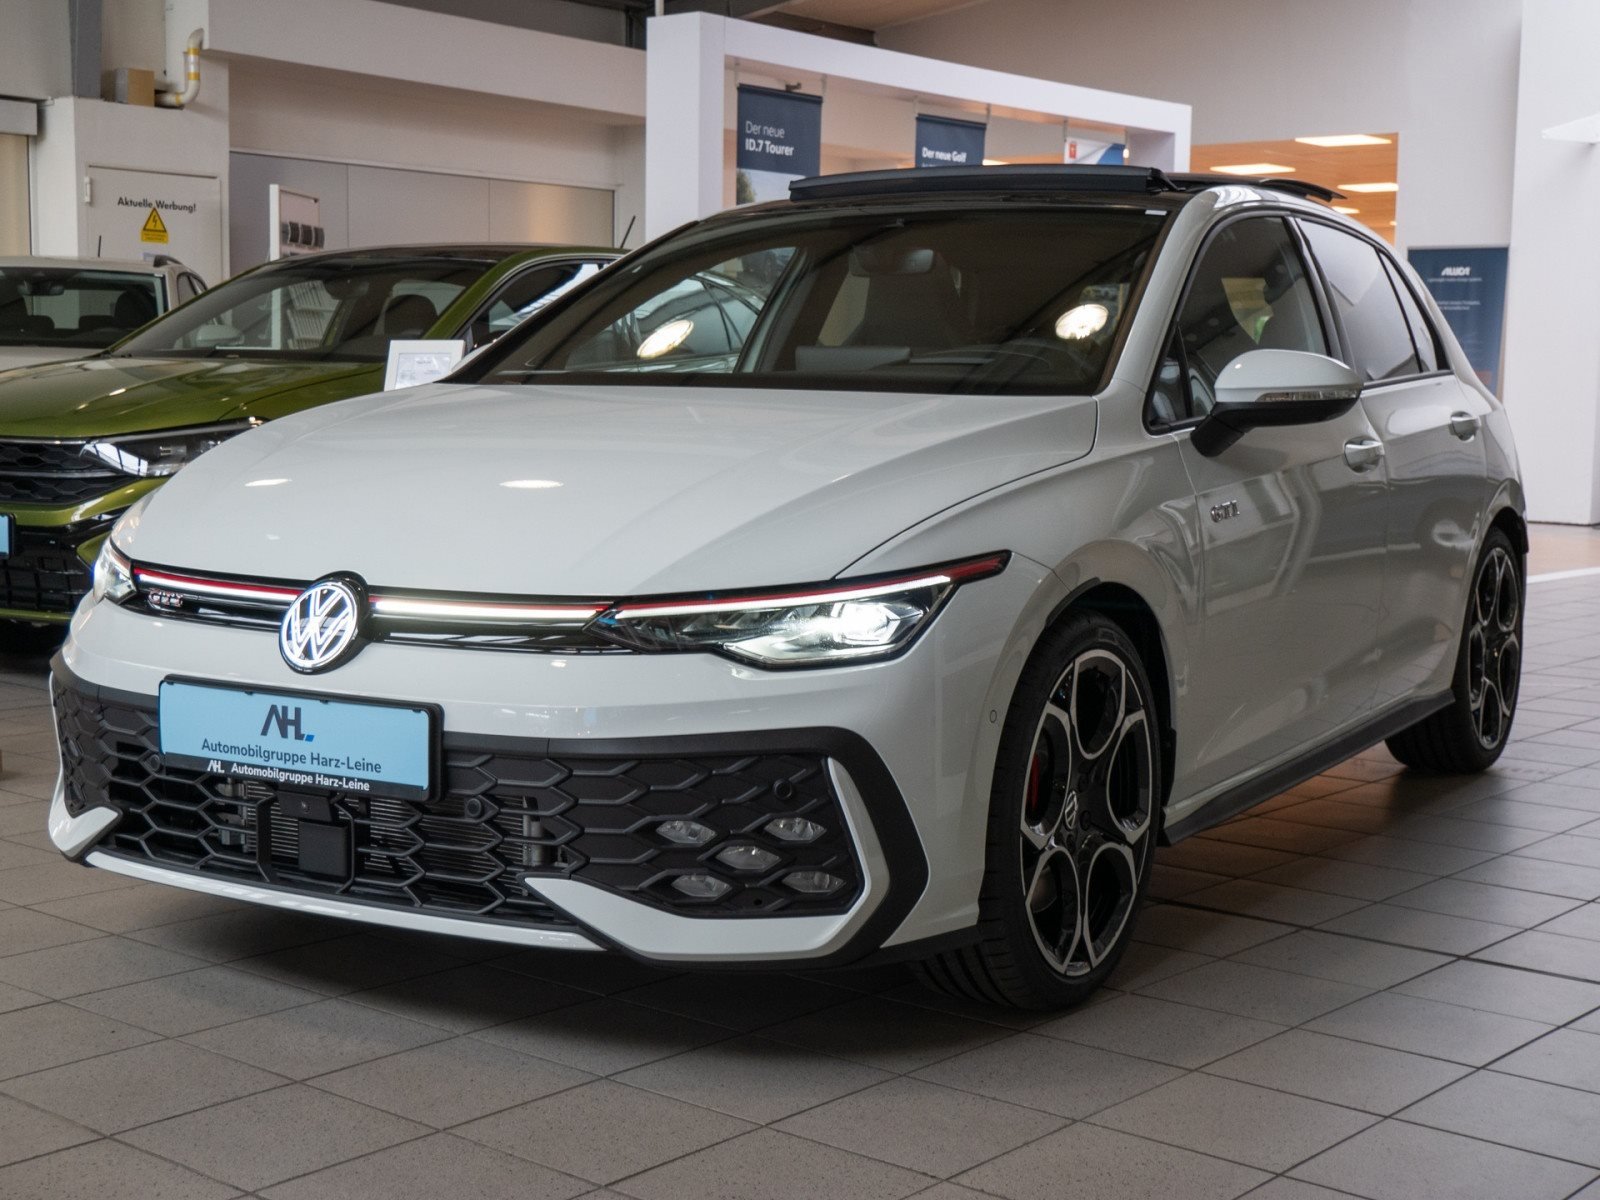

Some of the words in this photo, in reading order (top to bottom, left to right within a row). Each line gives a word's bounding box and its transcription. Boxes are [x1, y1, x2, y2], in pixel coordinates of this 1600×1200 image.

[745, 120, 761, 135] Der
[763, 126, 785, 138] neue
[745, 138, 764, 152] ID.7
[765, 140, 795, 156] Tourer
[922, 146, 935, 158] Der
[952, 151, 967, 163] Golf
[117, 197, 153, 208] Aktuelle
[155, 200, 196, 213] Werbung!
[201, 737, 307, 766] Automobilgruppe
[310, 751, 382, 774] Harz-Leine
[231, 763, 313, 784] Automobilgruppe
[315, 772, 370, 792] Harz-Leine
